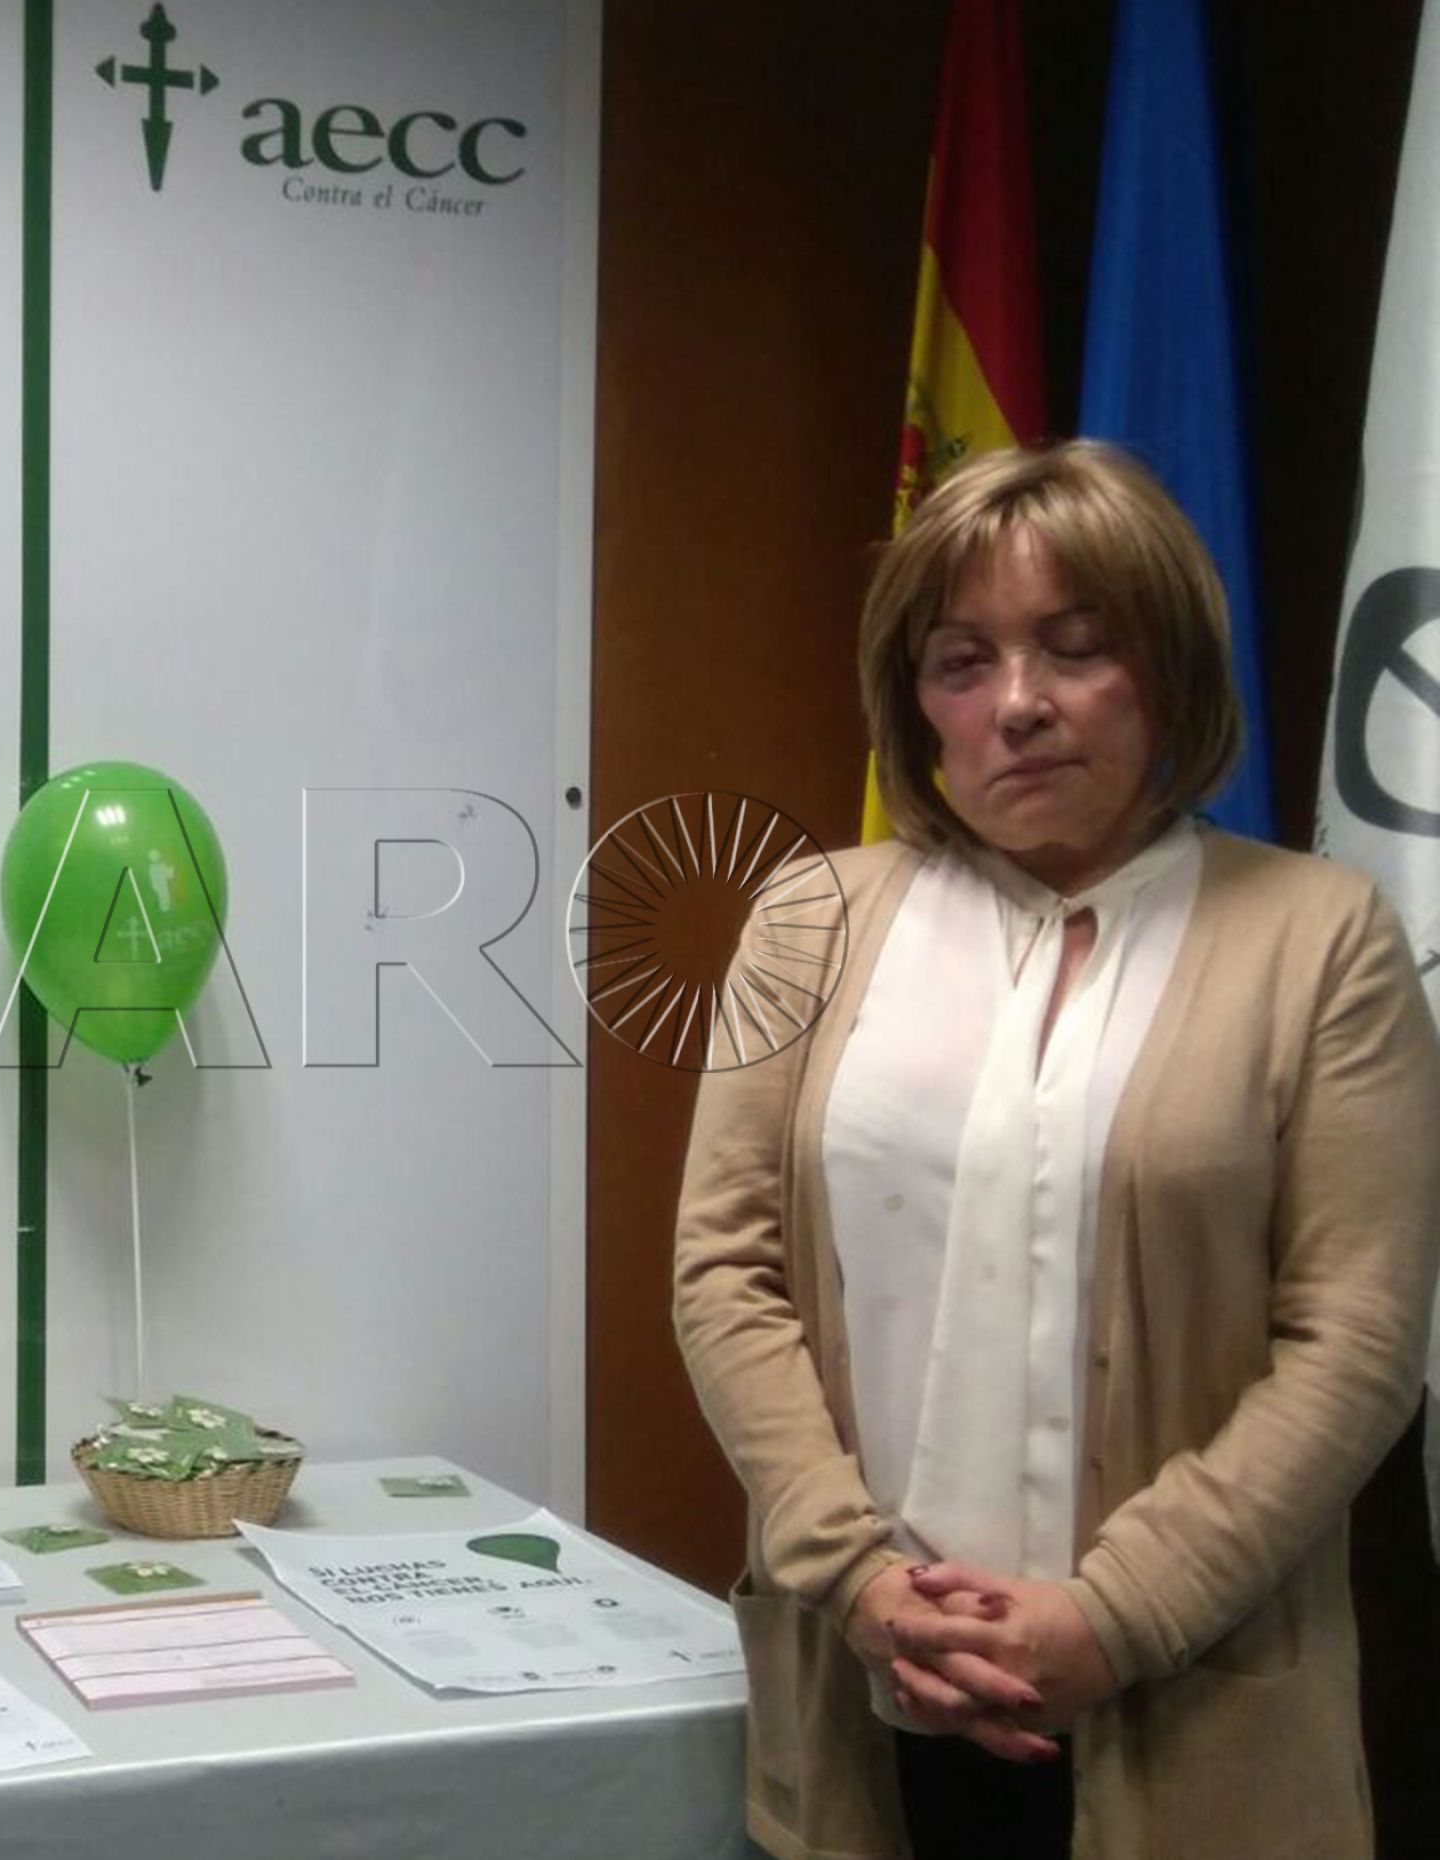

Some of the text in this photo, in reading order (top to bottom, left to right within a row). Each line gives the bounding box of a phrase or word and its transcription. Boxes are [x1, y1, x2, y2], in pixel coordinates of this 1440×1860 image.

[241, 97, 527, 185] aecc
[282, 177, 485, 216] Contra el Cáncer
[320, 1572, 432, 1587] CONTRA
[340, 1560, 447, 1577] LUCHAS
[345, 1593, 404, 1605] NOS
[411, 1583, 508, 1599] TIENES
